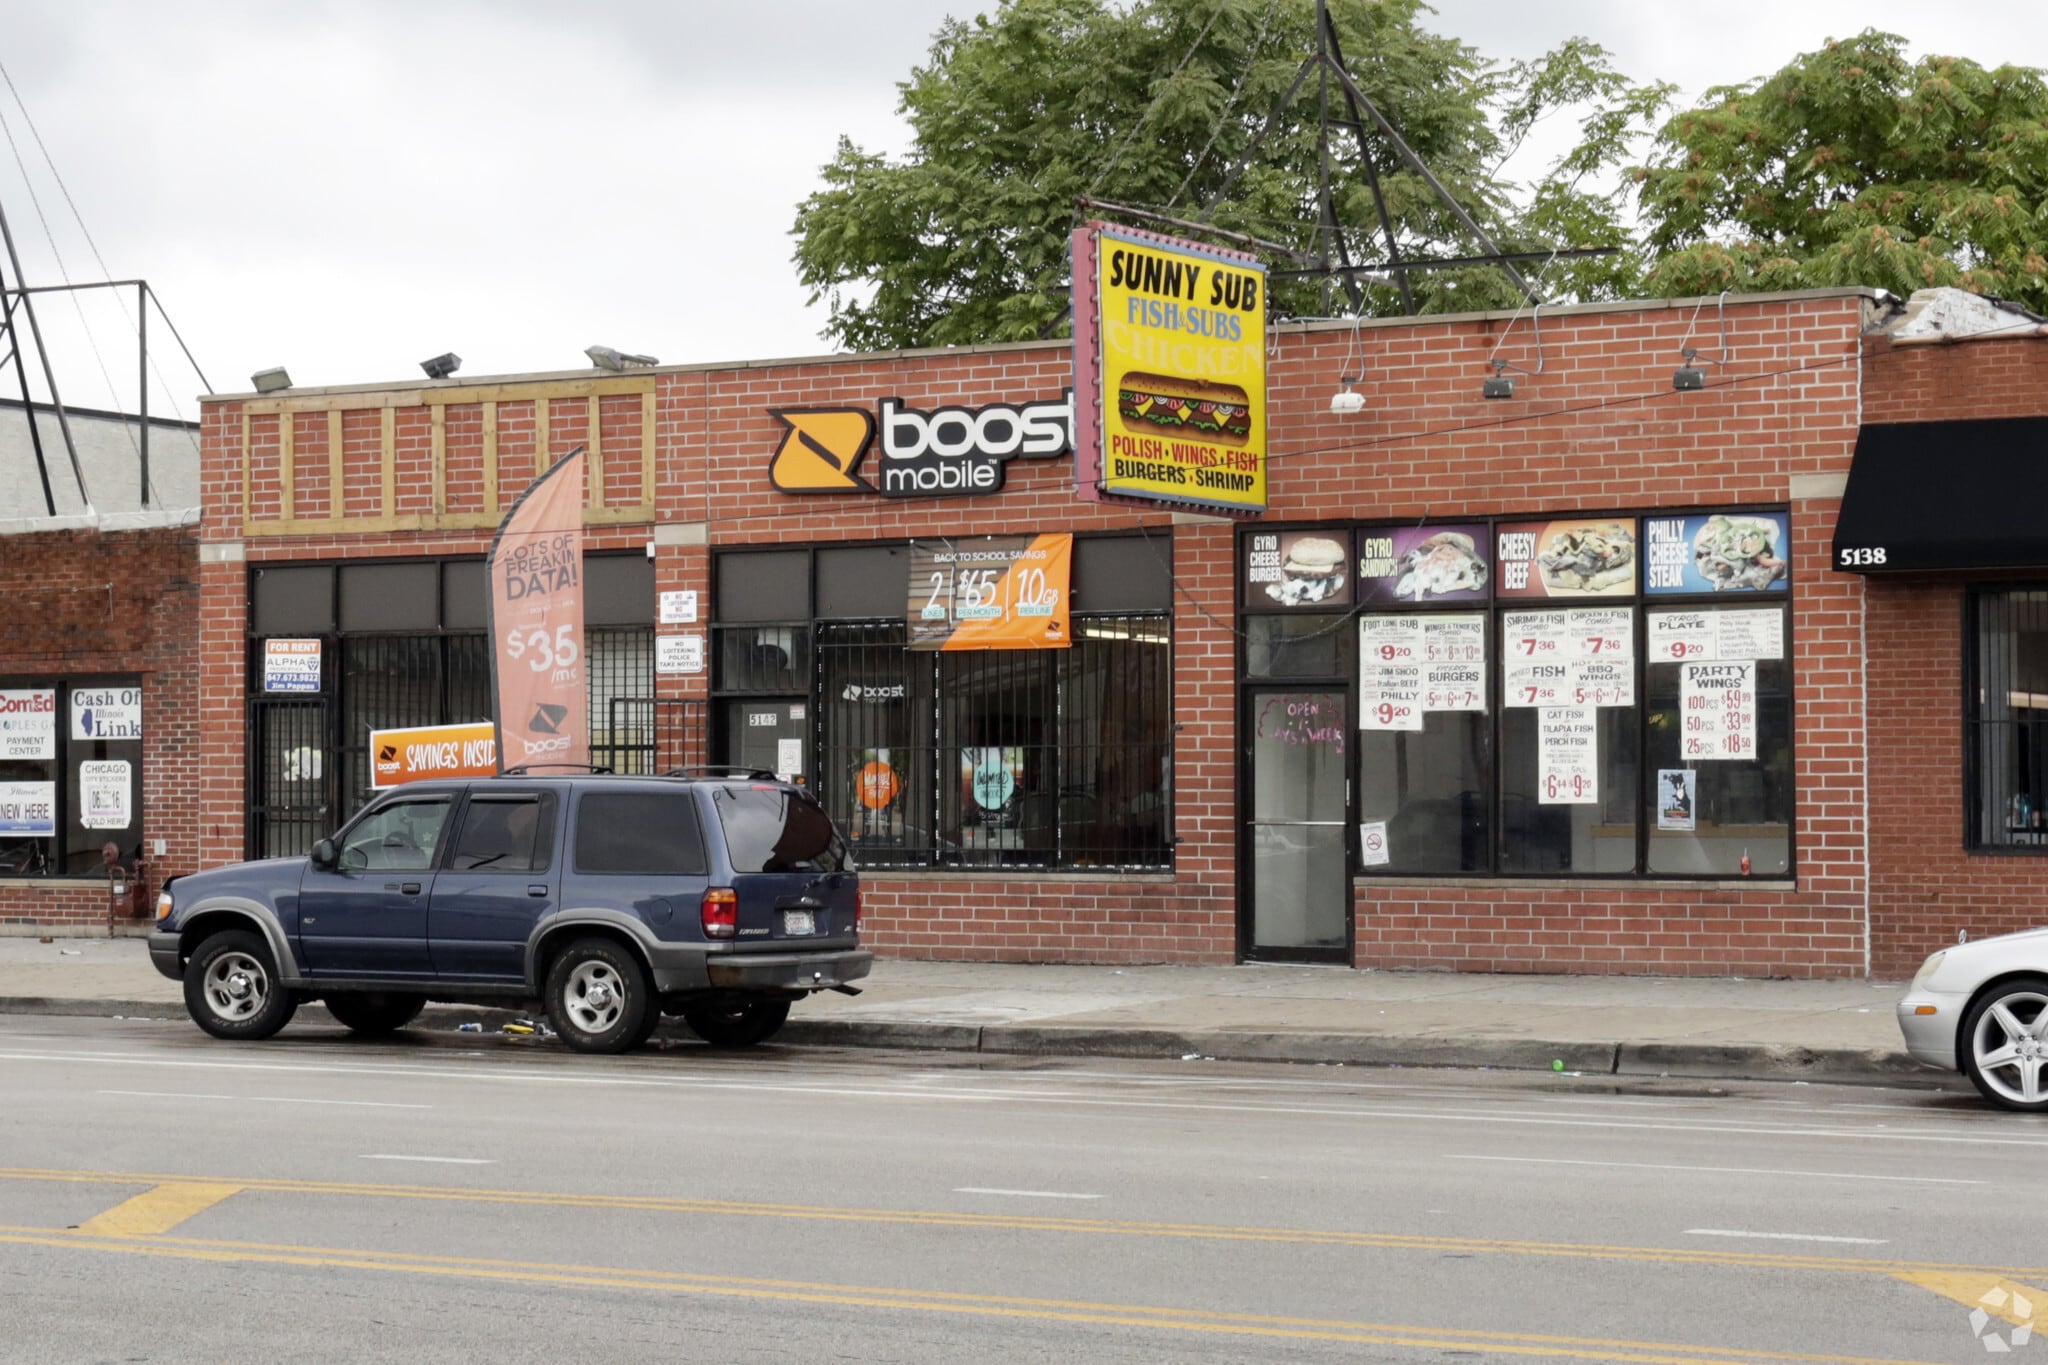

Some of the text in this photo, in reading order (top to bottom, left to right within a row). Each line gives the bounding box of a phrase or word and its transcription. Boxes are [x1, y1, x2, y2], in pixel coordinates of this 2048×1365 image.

[1110, 250, 1258, 311] SUNNY SUB
[1106, 319, 1263, 375] CHICKEN
[1112, 435, 1258, 472] POLISH WINGS FISH
[886, 459, 995, 491] mobile
[1115, 459, 1255, 492] BURGERS SHRIMP
[1649, 519, 1685, 543] PHILLY
[504, 534, 573, 561] LOTS OF
[1254, 535, 1277, 551] GYRO
[1365, 537, 1393, 558] GYRO
[1499, 532, 1536, 561] CHEESY
[934, 550, 1046, 563] BACK TO SCHOOL SAVINGS
[1250, 551, 1281, 567] CHEESE
[1649, 542, 1689, 565] CHEESE
[1840, 547, 1887, 566] 5138
[506, 547, 575, 576] FREAKIN
[1360, 557, 1399, 578] SANDWICH
[506, 563, 577, 600] DATA!
[1250, 566, 1281, 583] BURGER
[1504, 561, 1529, 590] BEEF
[1649, 564, 1683, 588] STEAK
[926, 572, 943, 609] 2
[960, 569, 997, 608] $65
[923, 609, 943, 618] LINES
[977, 608, 1000, 616] MONTH
[1020, 606, 1051, 615] PER LINE
[1570, 611, 1602, 622] CHICKEN
[1610, 611, 1629, 620] FISH
[1363, 620, 1380, 632] FOOT
[1399, 619, 1418, 630] SUB
[1506, 615, 1539, 628] SHRIMP
[1546, 614, 1565, 625] FISH
[1658, 620, 1705, 630] PLATE
[270, 643, 317, 652] FOR RENT
[507, 624, 578, 672] $35
[1378, 668, 1418, 676] JIM SHOO
[1428, 671, 1479, 682] BURGERS
[1532, 666, 1566, 678] FISH
[1587, 665, 1613, 673] BBQ
[1688, 665, 1752, 680] PARTY
[1579, 673, 1621, 681] WINGS
[1696, 679, 1742, 689] WINGS
[864, 684, 904, 697] boost
[1381, 691, 1419, 700] PHILLY
[0, 694, 54, 713] ComEd
[74, 691, 115, 706] Cash
[95, 709, 124, 718] Illinois
[1287, 702, 1319, 715] OPEN
[1547, 711, 1584, 719] CAT FISH
[95, 720, 141, 737] Link
[1543, 725, 1594, 733] TILAPIA FISH
[6, 736, 45, 744] PAYMENT
[1545, 737, 1587, 746] PERCH FISH
[9, 747, 41, 755] CENTER
[406, 741, 459, 772] SAVINGS
[85, 765, 126, 774] CHICAGO
[25, 803, 49, 819] HERE
[86, 818, 105, 826] SOLD
